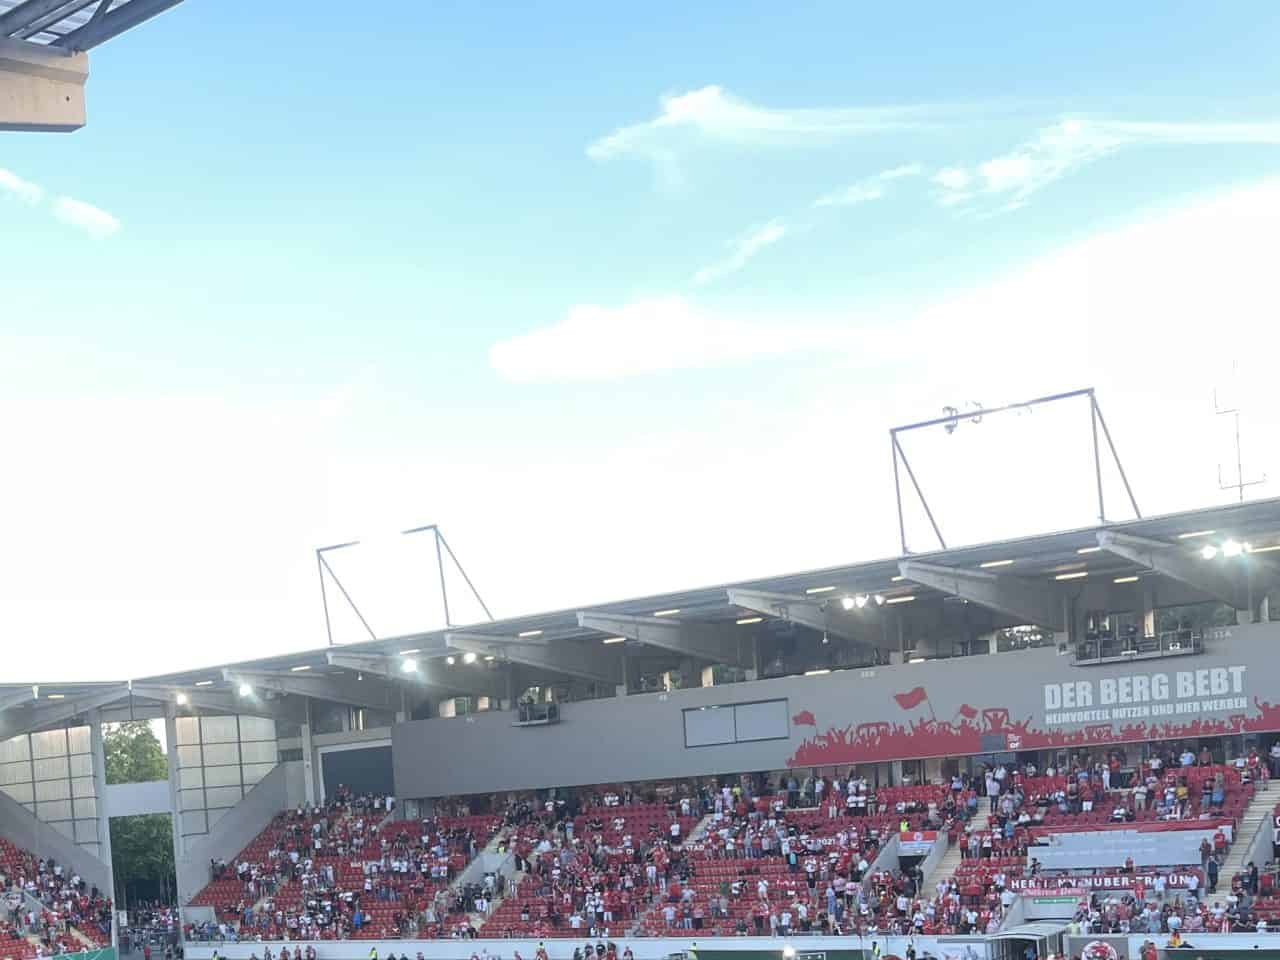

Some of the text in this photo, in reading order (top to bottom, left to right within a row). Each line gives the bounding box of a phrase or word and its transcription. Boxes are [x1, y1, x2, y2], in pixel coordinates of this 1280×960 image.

[1044, 665, 1246, 710] DER BERG BEBT
